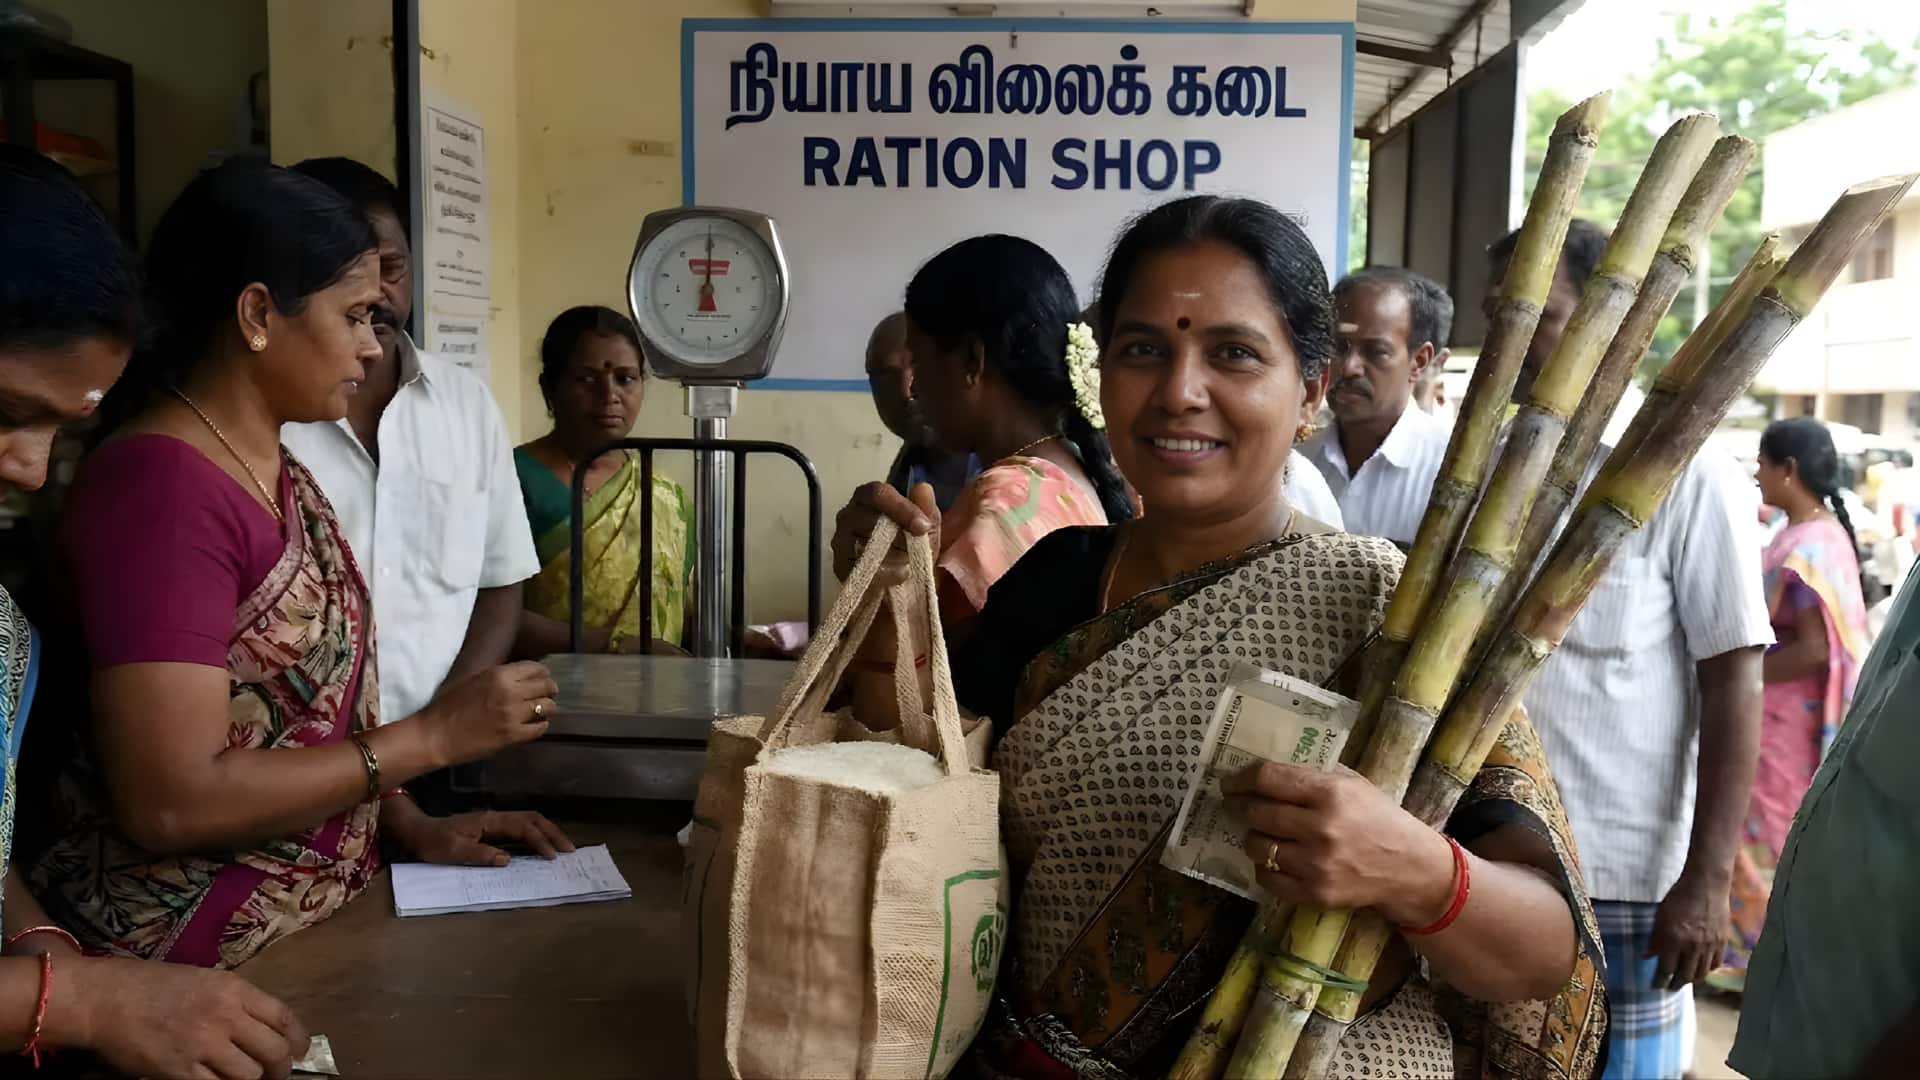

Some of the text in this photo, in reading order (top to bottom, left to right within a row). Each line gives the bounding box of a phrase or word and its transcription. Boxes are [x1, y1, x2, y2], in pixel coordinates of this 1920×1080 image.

[725, 42, 1307, 130] நியாய விலைக் கடை
[804, 137, 1221, 190] RATION SHOP
